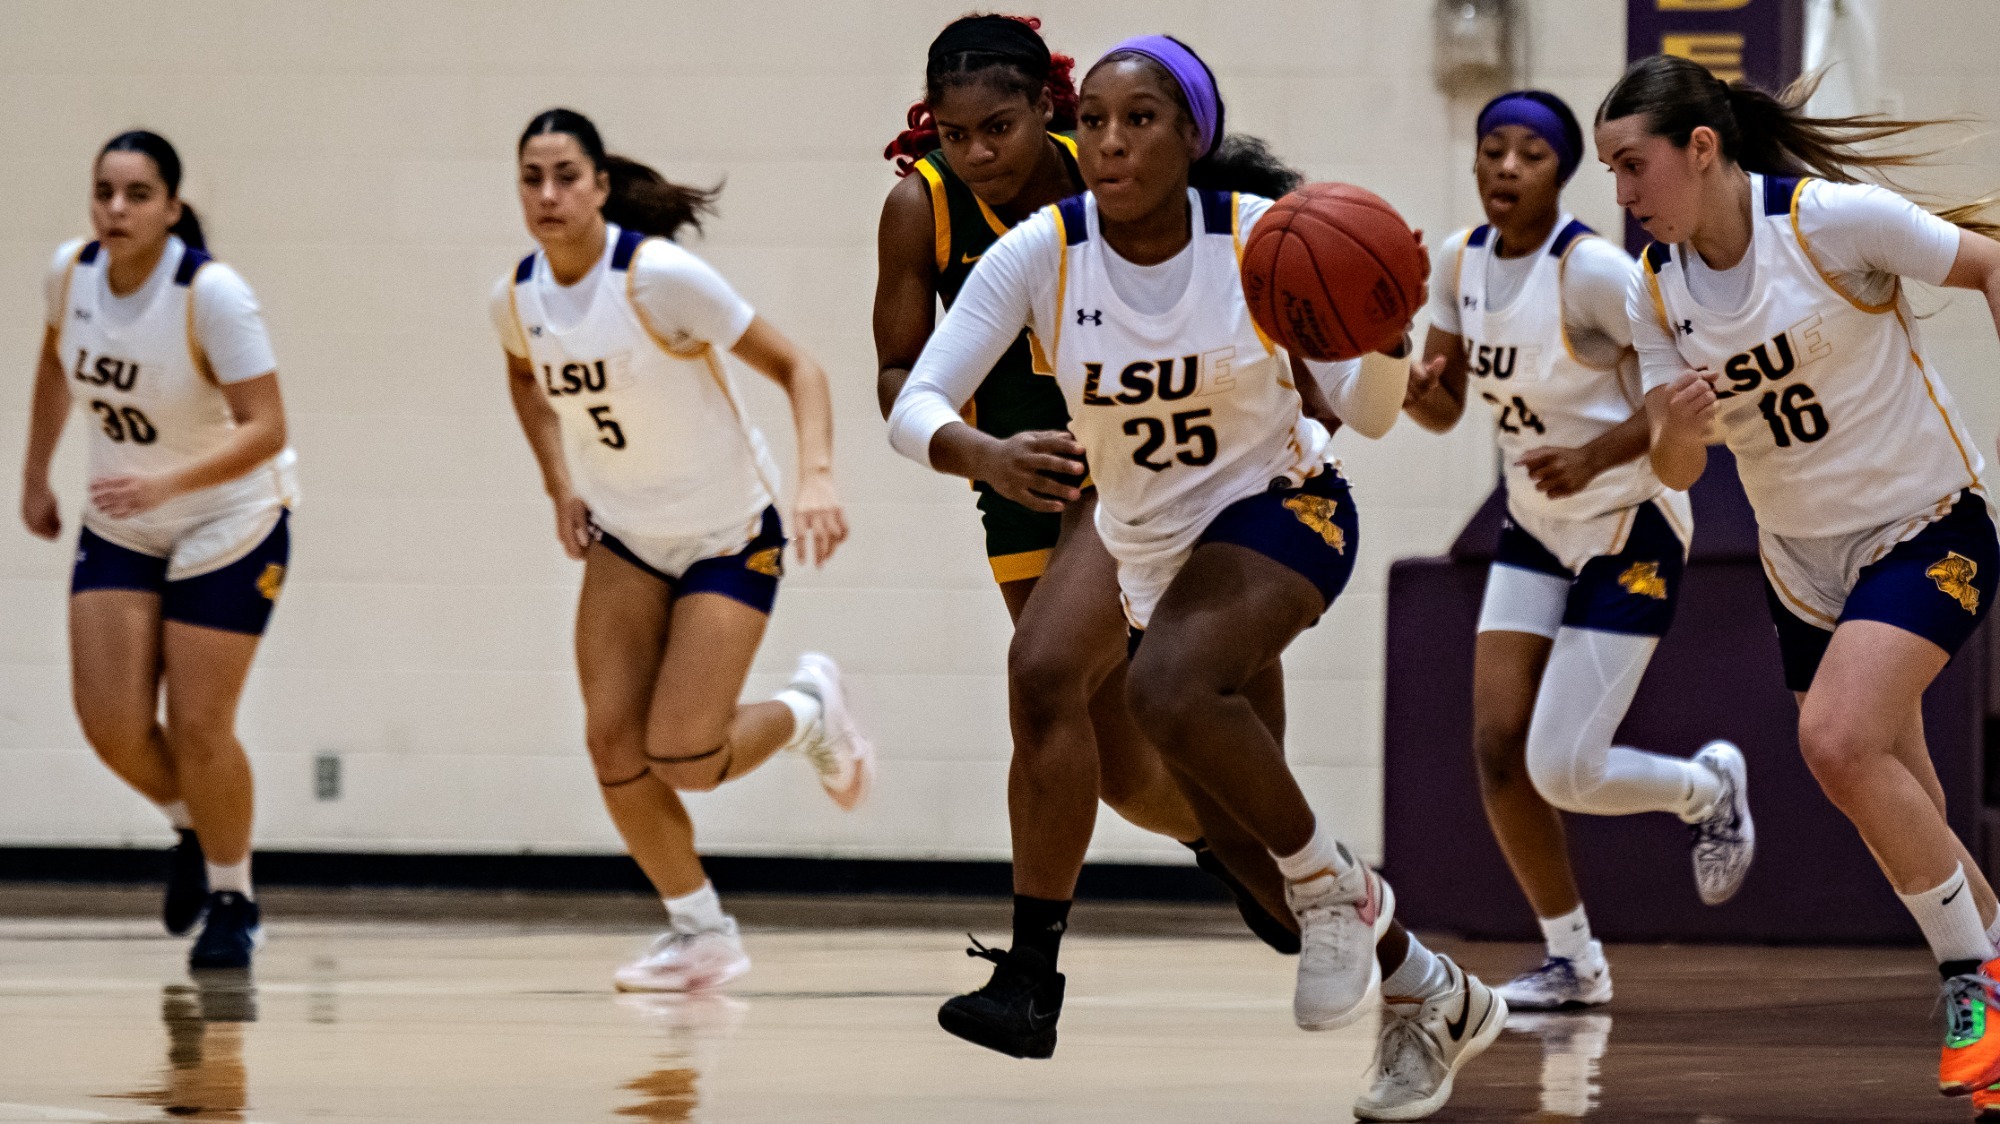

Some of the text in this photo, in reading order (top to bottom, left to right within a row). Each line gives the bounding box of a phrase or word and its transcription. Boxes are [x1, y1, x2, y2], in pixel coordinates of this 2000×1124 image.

[1082, 345, 1236, 406] LSUE
[91, 399, 158, 445] 30
[587, 405, 627, 450] 5
[1122, 407, 1218, 472] 25
[1482, 392, 1546, 435] 24
[1758, 383, 1829, 447] 16
